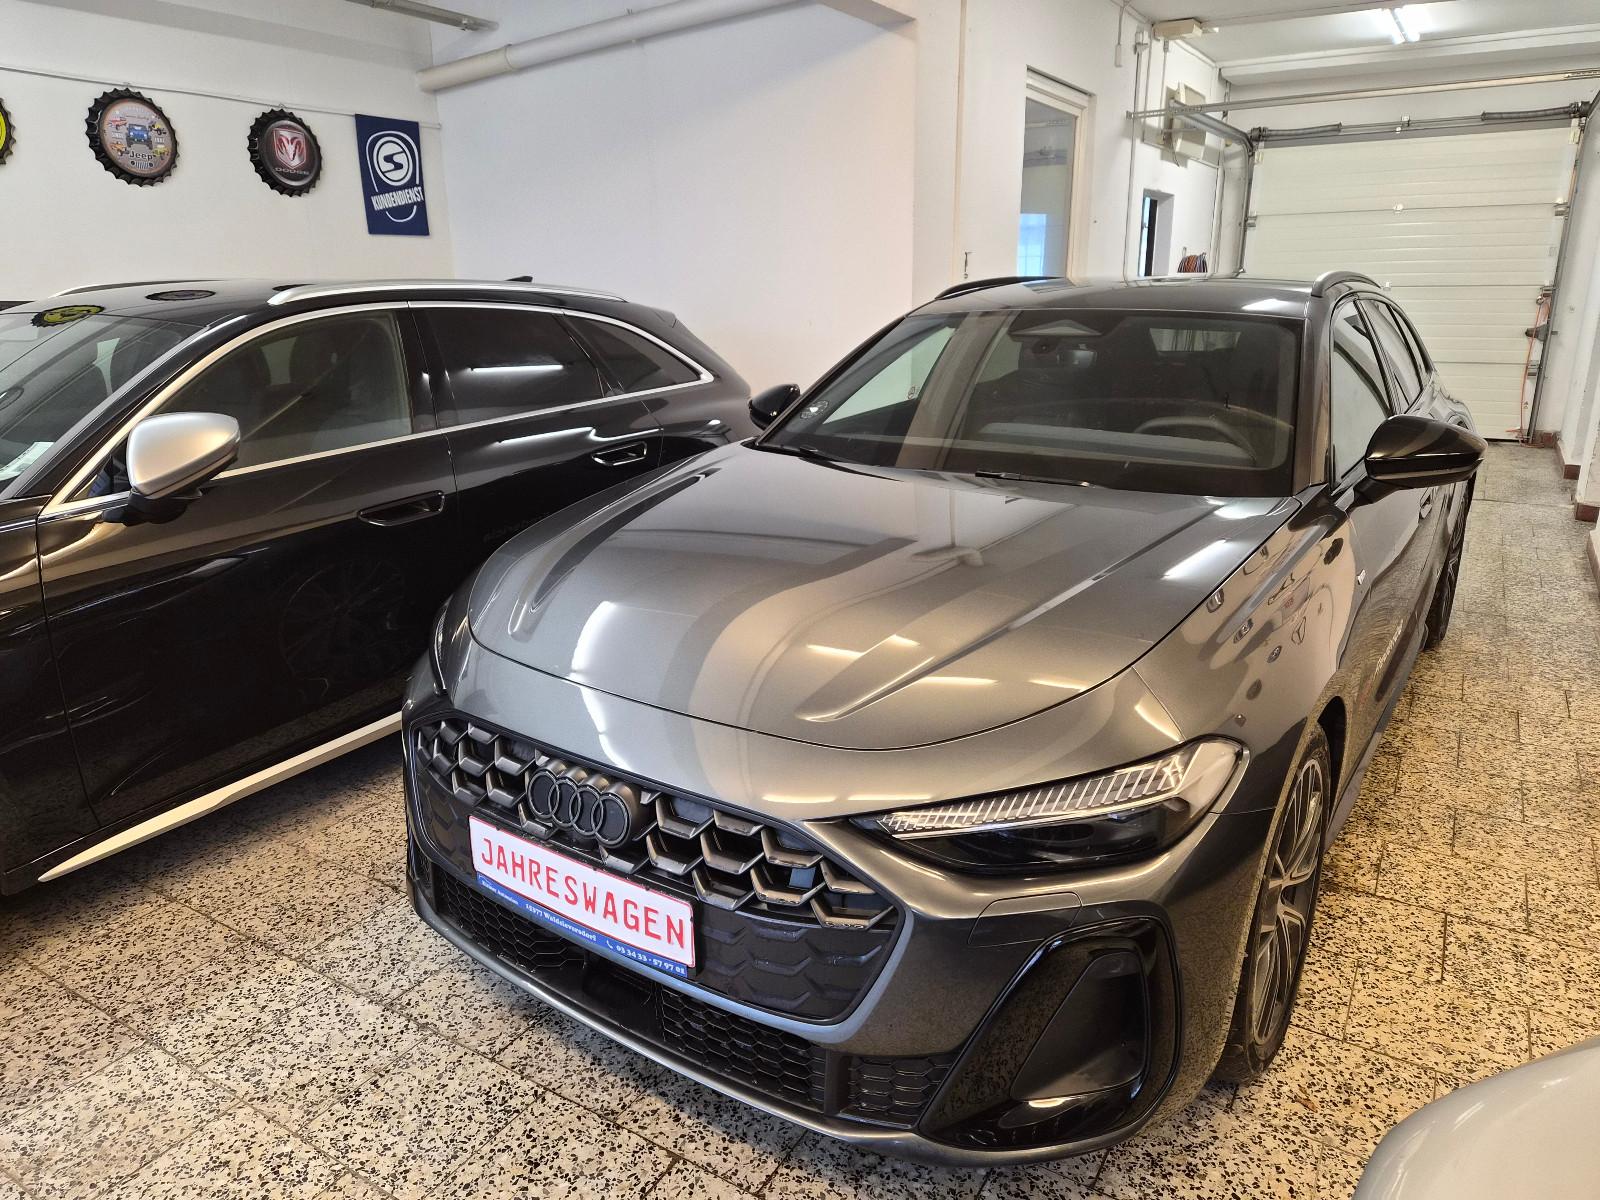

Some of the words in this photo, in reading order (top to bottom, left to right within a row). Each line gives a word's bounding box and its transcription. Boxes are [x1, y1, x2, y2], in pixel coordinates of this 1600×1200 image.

[129, 151, 153, 162] Jeep
[274, 166, 310, 175] DODGE
[371, 187, 425, 211] KUNDENDIENST
[481, 838, 685, 949] JAHRESWAGEN
[543, 912, 597, 942] Waldsieversdorf
